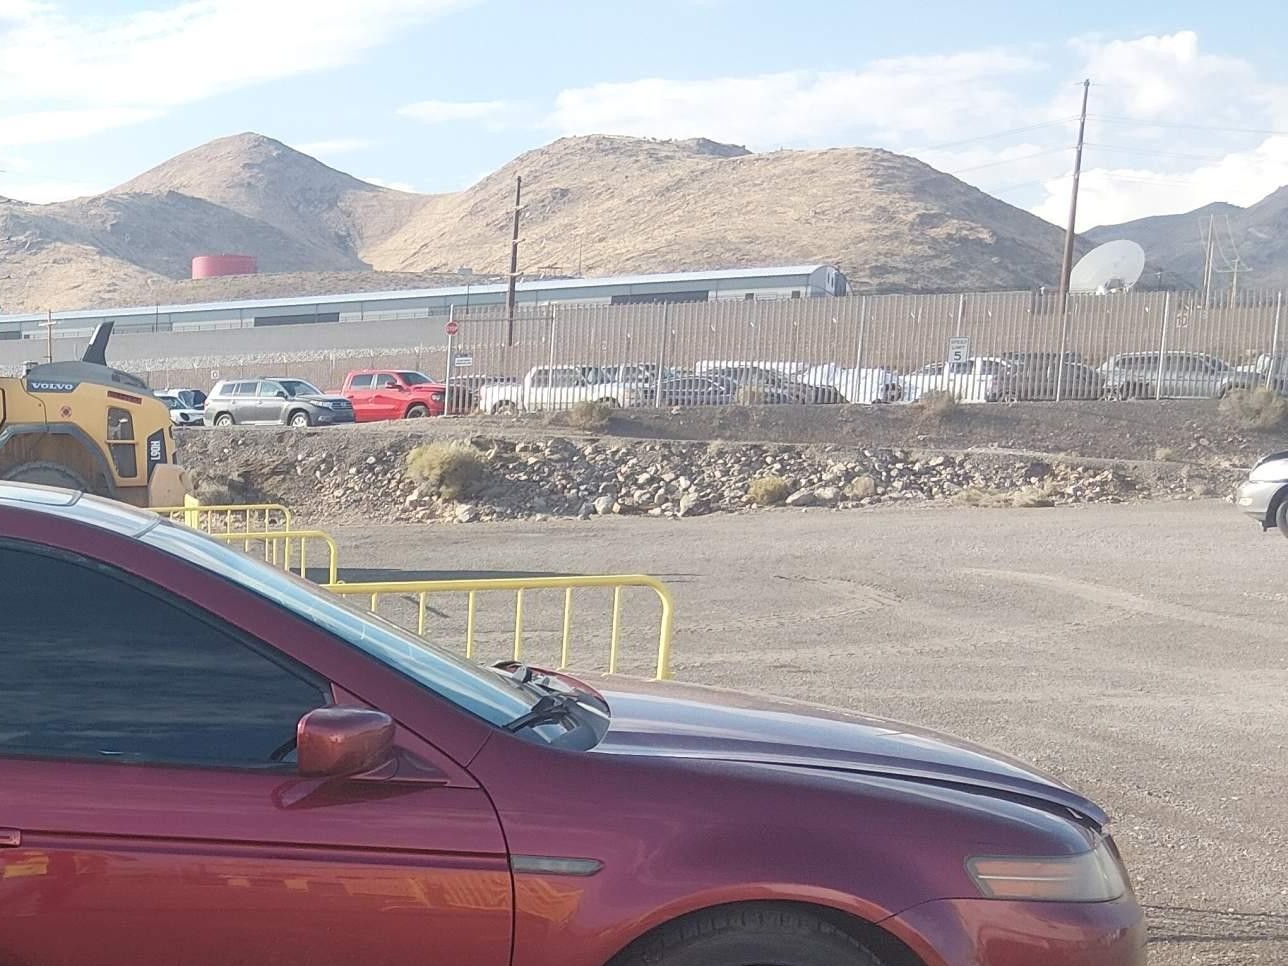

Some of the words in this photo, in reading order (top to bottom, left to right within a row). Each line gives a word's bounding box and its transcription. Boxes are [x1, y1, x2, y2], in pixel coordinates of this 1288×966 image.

[953, 351, 962, 361] 5
[31, 382, 74, 391] VOLVO
[150, 440, 161, 461] L90H
